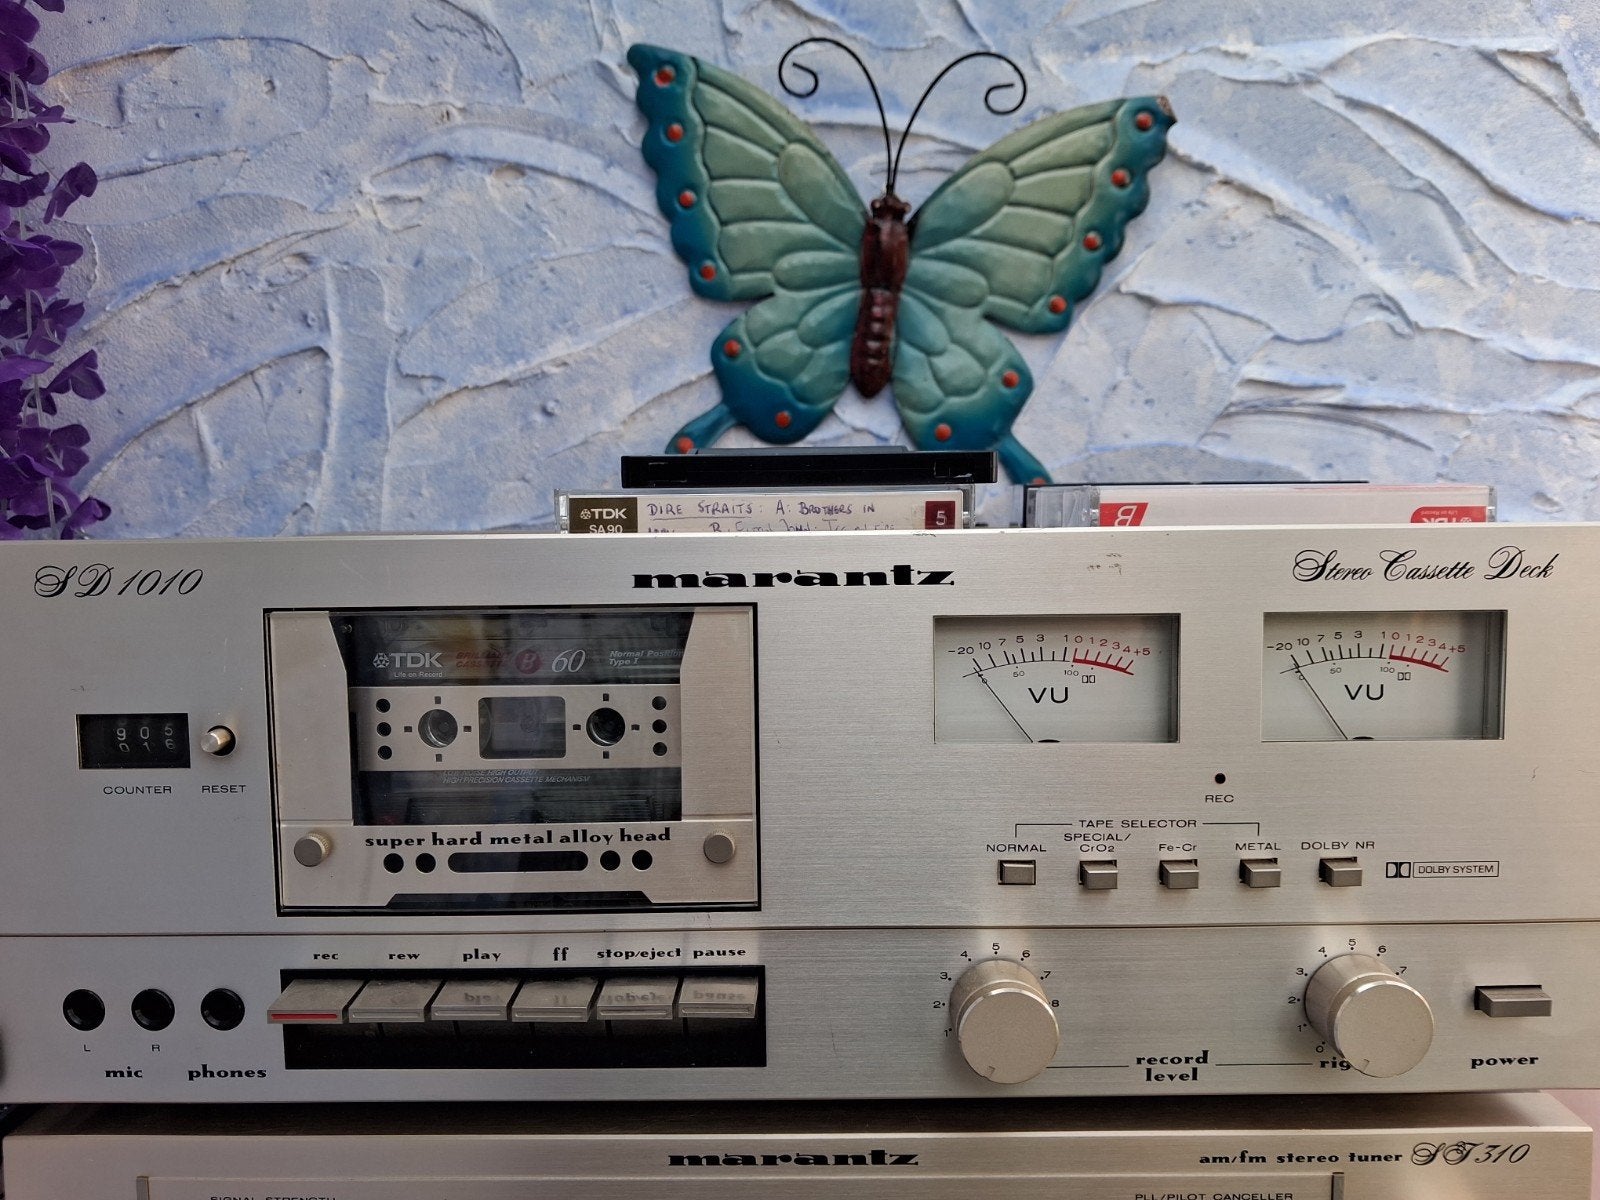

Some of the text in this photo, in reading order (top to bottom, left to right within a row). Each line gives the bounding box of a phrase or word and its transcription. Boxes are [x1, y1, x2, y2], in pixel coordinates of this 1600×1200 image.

[591, 508, 628, 520] TDK
[647, 503, 683, 516] DIRE
[799, 502, 853, 516] BROTHERS
[863, 502, 875, 513] IN
[936, 510, 948, 526] 5
[1292, 545, 1559, 583] Stereo Cassette Deck
[117, 568, 204, 596] 1010
[632, 565, 956, 589] marantz
[979, 641, 992, 650] 10
[999, 638, 1006, 646] 7
[1016, 635, 1024, 643] 5
[1036, 634, 1045, 642] 3
[1074, 635, 1083, 643] 0
[1099, 639, 1108, 647] 2
[1112, 641, 1121, 649] 3
[1123, 645, 1131, 653] 4
[1297, 637, 1310, 646] 10
[1318, 635, 1326, 643] 7
[1334, 632, 1343, 640] 5
[1354, 631, 1362, 639] 3
[1392, 632, 1400, 640] 0
[1416, 636, 1424, 644] 2
[1428, 639, 1437, 647] 3
[1439, 642, 1446, 650] 4
[390, 653, 444, 668] TDK
[551, 649, 586, 673] 60
[610, 650, 644, 659] Normal
[609, 658, 631, 667] Type
[1013, 670, 1025, 678] 50
[1064, 669, 1080, 677] 100
[1380, 666, 1395, 674] 100
[1028, 687, 1069, 704] VU
[1344, 684, 1384, 701] VU
[103, 786, 172, 795] COUNTER
[202, 785, 247, 794] RESET
[1205, 795, 1234, 804] REC
[1079, 819, 1197, 829] TAPE SELECTOR
[365, 827, 671, 850] super hard metal alloy head
[1064, 832, 1132, 842] SPECIAL/
[986, 843, 1047, 852] NORMAL
[1159, 843, 1197, 852] Fe-Cr
[1235, 841, 1281, 851] METAL
[1301, 840, 1376, 850] DOLBY NR
[1418, 863, 1494, 875] DOLBY SYSTEM
[313, 951, 339, 961] rec
[388, 952, 421, 961] rew
[462, 948, 501, 963] play
[552, 947, 569, 961] ff
[596, 946, 682, 962] stop/eject
[693, 947, 747, 960] pause
[940, 971, 948, 979] 3
[992, 943, 1000, 951] 5
[1022, 950, 1030, 958] 6
[1043, 971, 1051, 979] 7
[1051, 999, 1060, 1008] 8
[1288, 996, 1296, 1004] 2
[1296, 968, 1304, 976] 3
[1318, 946, 1326, 954] 4
[1348, 938, 1356, 946] 5
[1378, 945, 1386, 954] 6
[1399, 966, 1407, 974] 7
[83, 1044, 91, 1052] L
[152, 1044, 160, 1052] R
[1136, 1050, 1209, 1066] record
[1320, 1057, 1352, 1071] rig
[1471, 1055, 1539, 1069] power
[105, 1066, 143, 1078] mic
[188, 1064, 267, 1081] phones
[1146, 1067, 1198, 1082] level
[668, 1150, 919, 1167] marantz
[1199, 1150, 1266, 1164] am/fm
[1276, 1152, 1339, 1164] stereo
[1348, 1152, 1402, 1163] tuner
[1475, 1143, 1531, 1164] 310
[1213, 1192, 1294, 1200] CANCELLER
